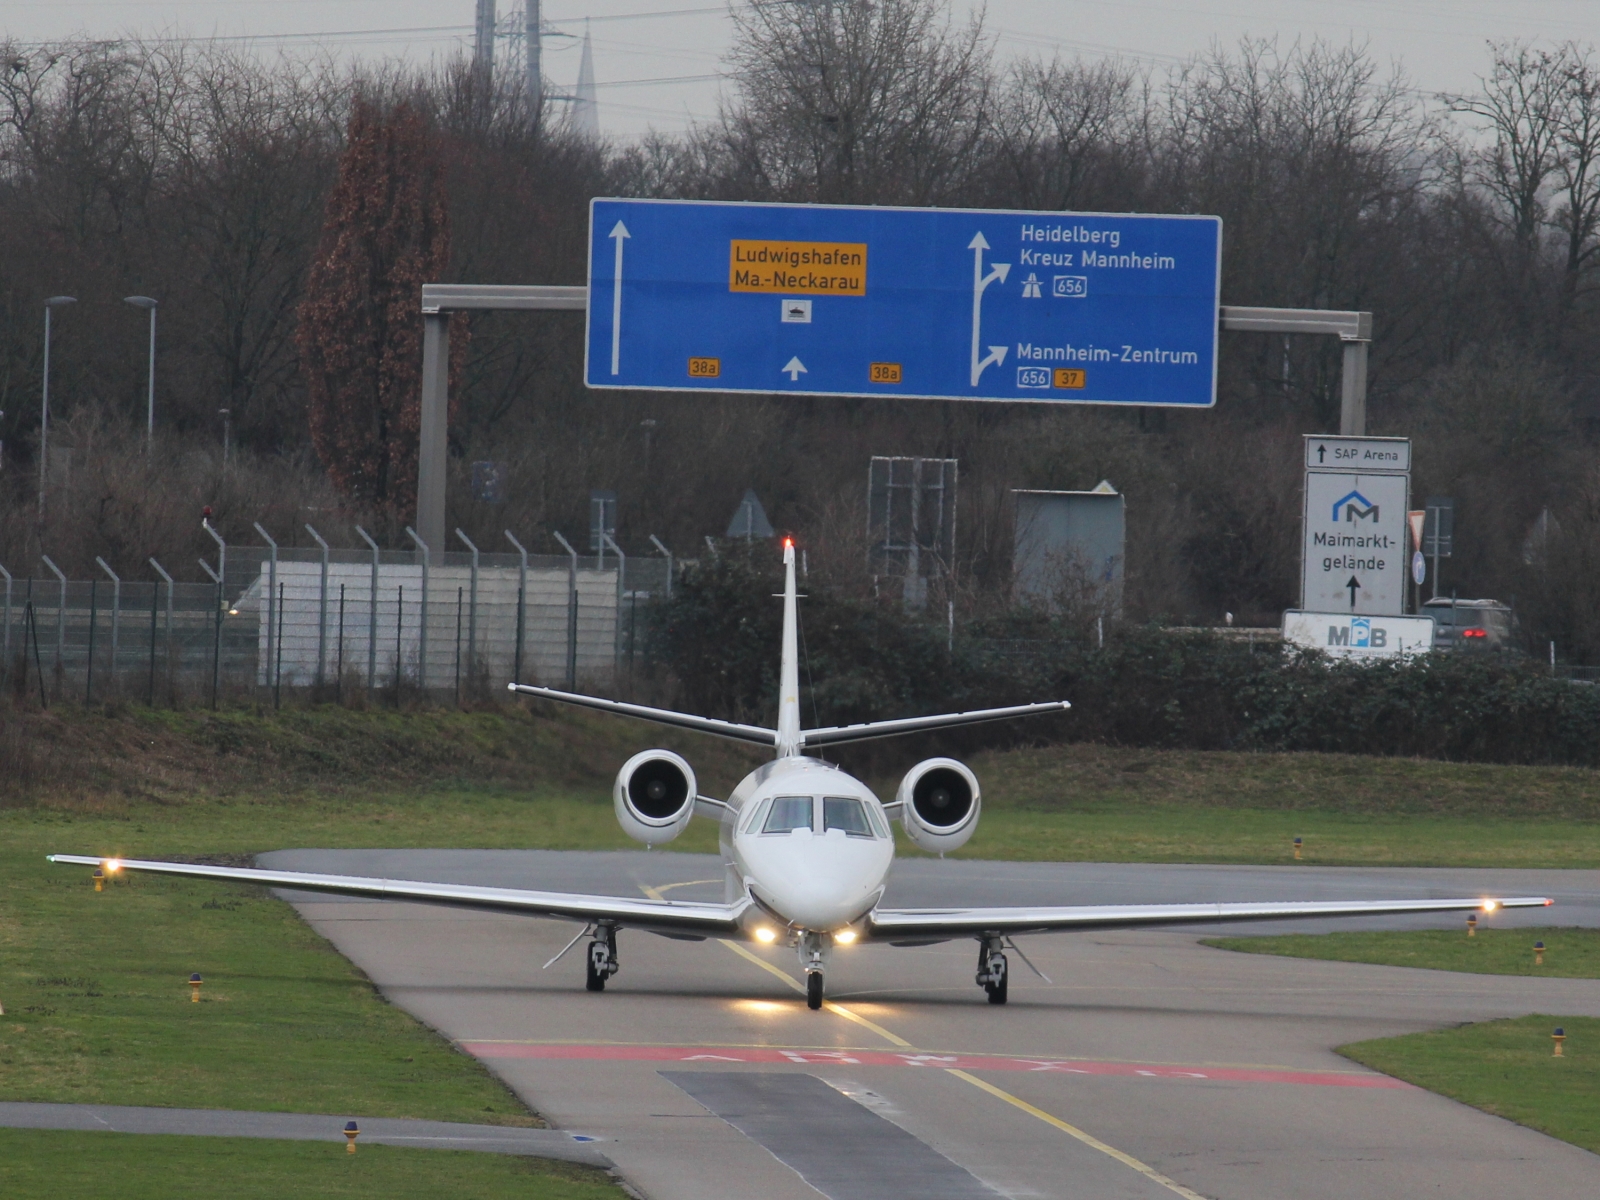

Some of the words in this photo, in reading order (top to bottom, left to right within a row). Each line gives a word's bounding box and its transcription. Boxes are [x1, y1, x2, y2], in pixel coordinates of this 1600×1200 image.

[1021, 224, 1120, 247] Heidelberg
[736, 246, 861, 268] Ludwigshafen
[1020, 249, 1073, 266] Kreuz
[1081, 250, 1175, 269] Mannheim
[735, 270, 859, 289] Ma.-Neckarau
[1058, 279, 1082, 293] 656
[1017, 343, 1198, 364] Mannheim-Zentrum
[692, 361, 716, 374] 38a
[874, 367, 898, 380] 38a
[1021, 370, 1046, 384] 656
[1062, 372, 1077, 385] 37
[1334, 448, 1358, 460] SAP
[1364, 449, 1398, 461] Arena
[1314, 532, 1396, 549] Maimarkt-
[1323, 554, 1386, 572] gelände
[1328, 625, 1388, 648] MPB
